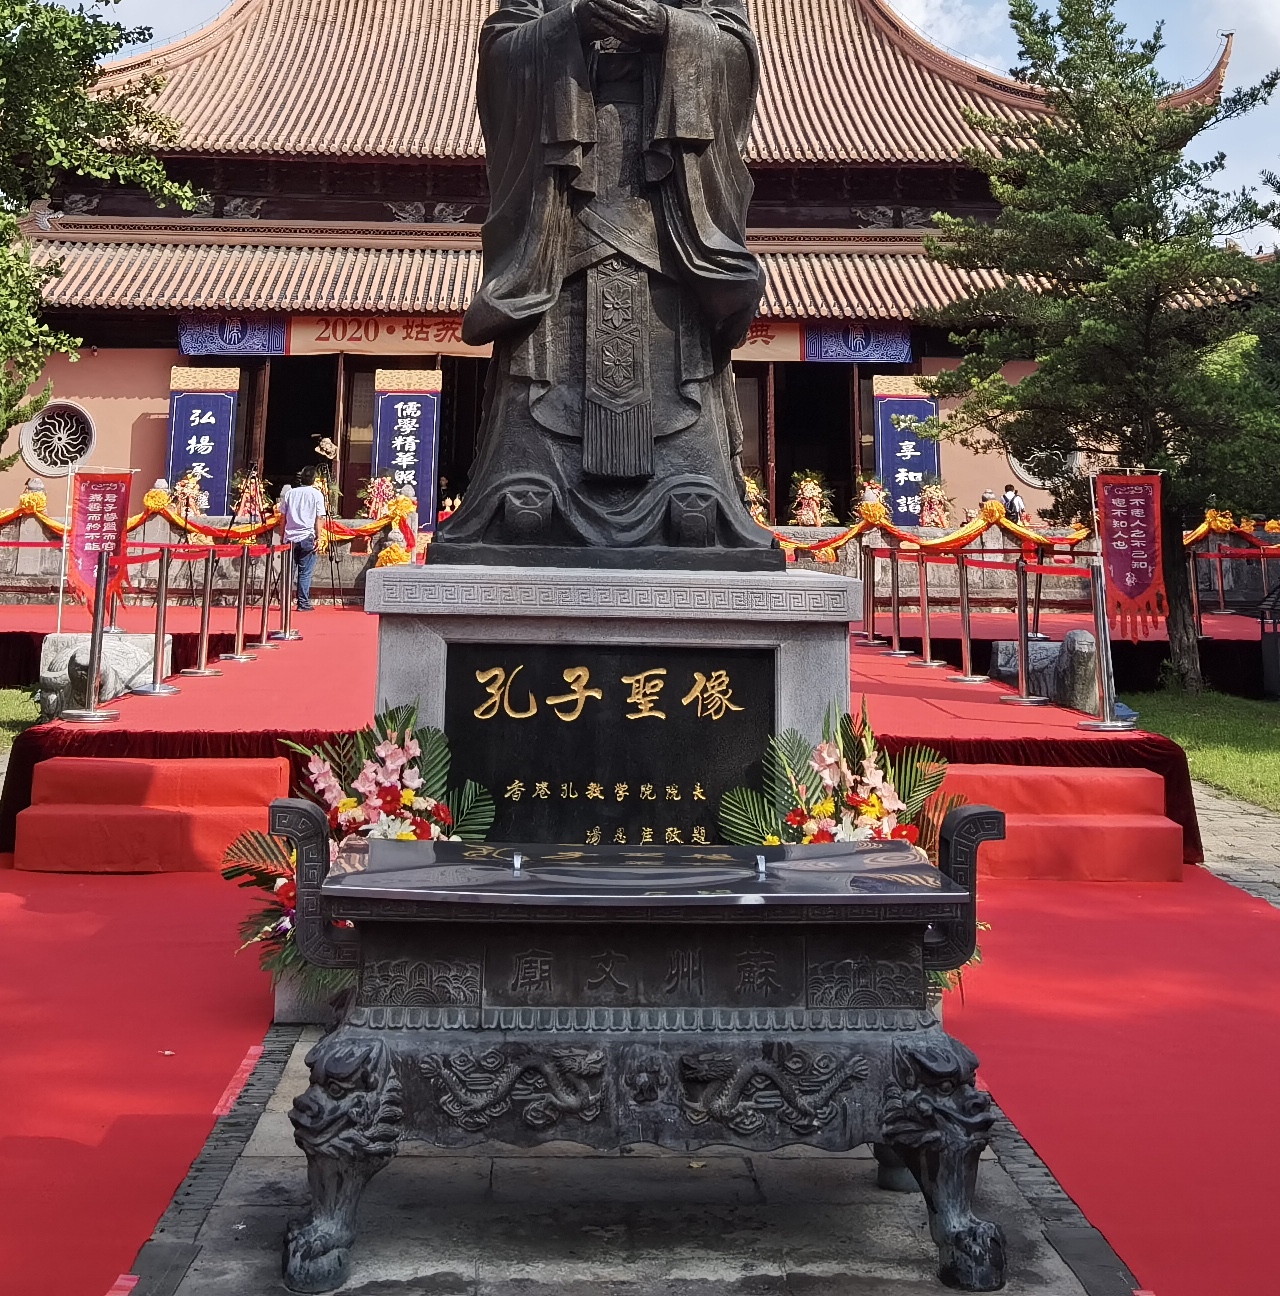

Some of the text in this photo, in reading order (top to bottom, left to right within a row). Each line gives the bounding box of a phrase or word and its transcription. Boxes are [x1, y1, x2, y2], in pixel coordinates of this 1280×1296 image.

[391, 401, 422, 497] 儒學精華照
[101, 493, 119, 557] 君子尊賢而容
[473, 665, 745, 722] 孔子聖像
